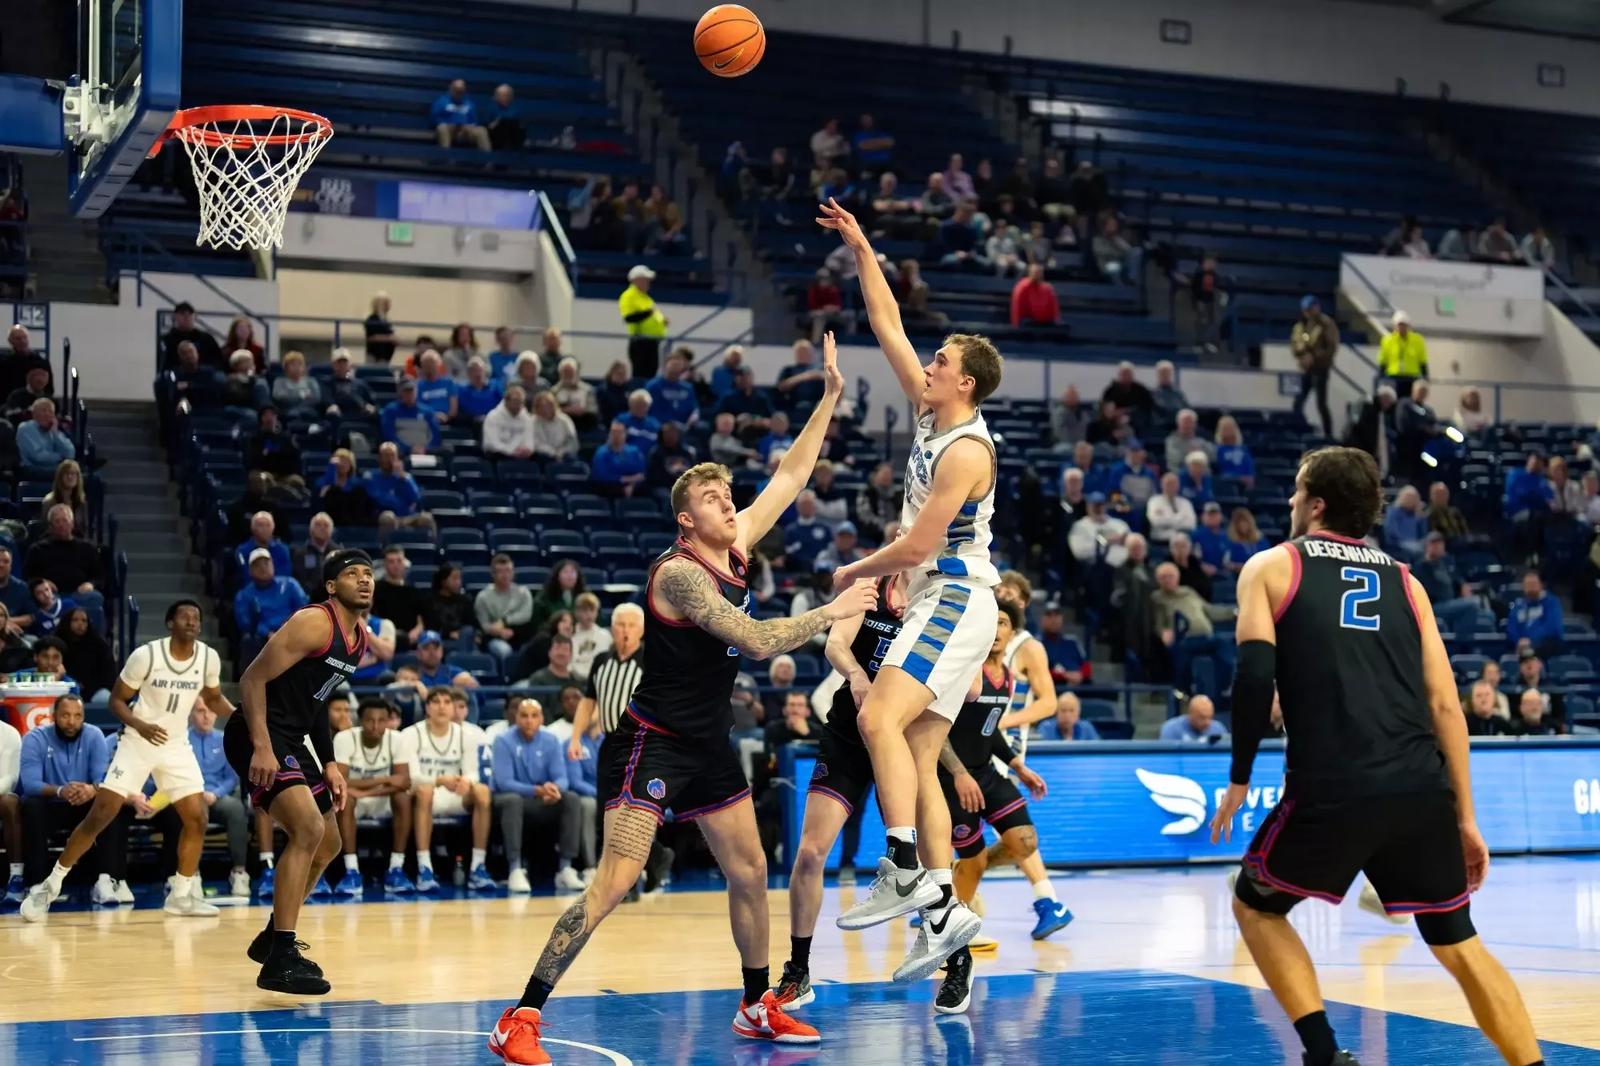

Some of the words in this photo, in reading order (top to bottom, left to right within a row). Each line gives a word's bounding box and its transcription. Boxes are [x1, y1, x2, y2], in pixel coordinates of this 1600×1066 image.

[1340, 566, 1380, 631] 2
[325, 656, 345, 670] BOISE
[869, 635, 892, 672] 5
[151, 679, 168, 688] AIR
[170, 681, 199, 690] FORCE
[313, 672, 345, 701] 11
[166, 694, 180, 714] 11
[981, 707, 1002, 737] 0
